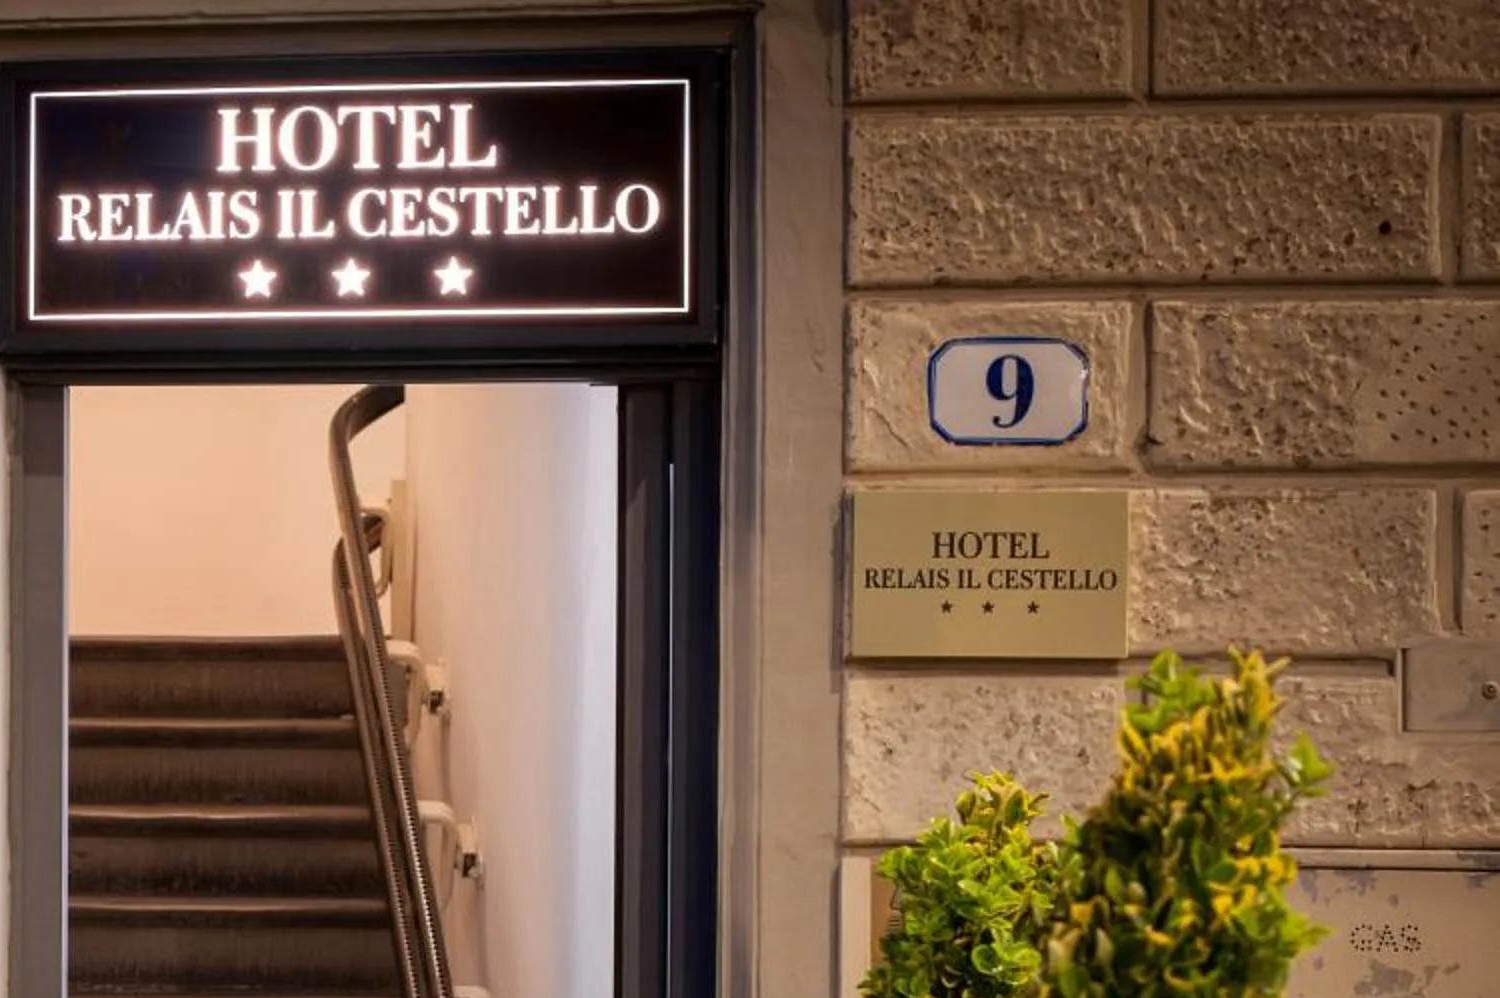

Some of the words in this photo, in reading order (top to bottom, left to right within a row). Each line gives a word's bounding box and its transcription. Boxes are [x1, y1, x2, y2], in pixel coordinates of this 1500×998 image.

[215, 103, 498, 172] HOTEL
[57, 191, 260, 243] RELAIS
[276, 190, 334, 239] IL
[347, 184, 660, 239] CESTELLO
[985, 354, 1034, 428] 9
[932, 531, 1050, 559] HOTEL
[864, 568, 950, 589] RELAIS
[957, 569, 981, 589] IL
[987, 569, 1117, 590] CESTELLO
[1350, 924, 1422, 952] GAS
